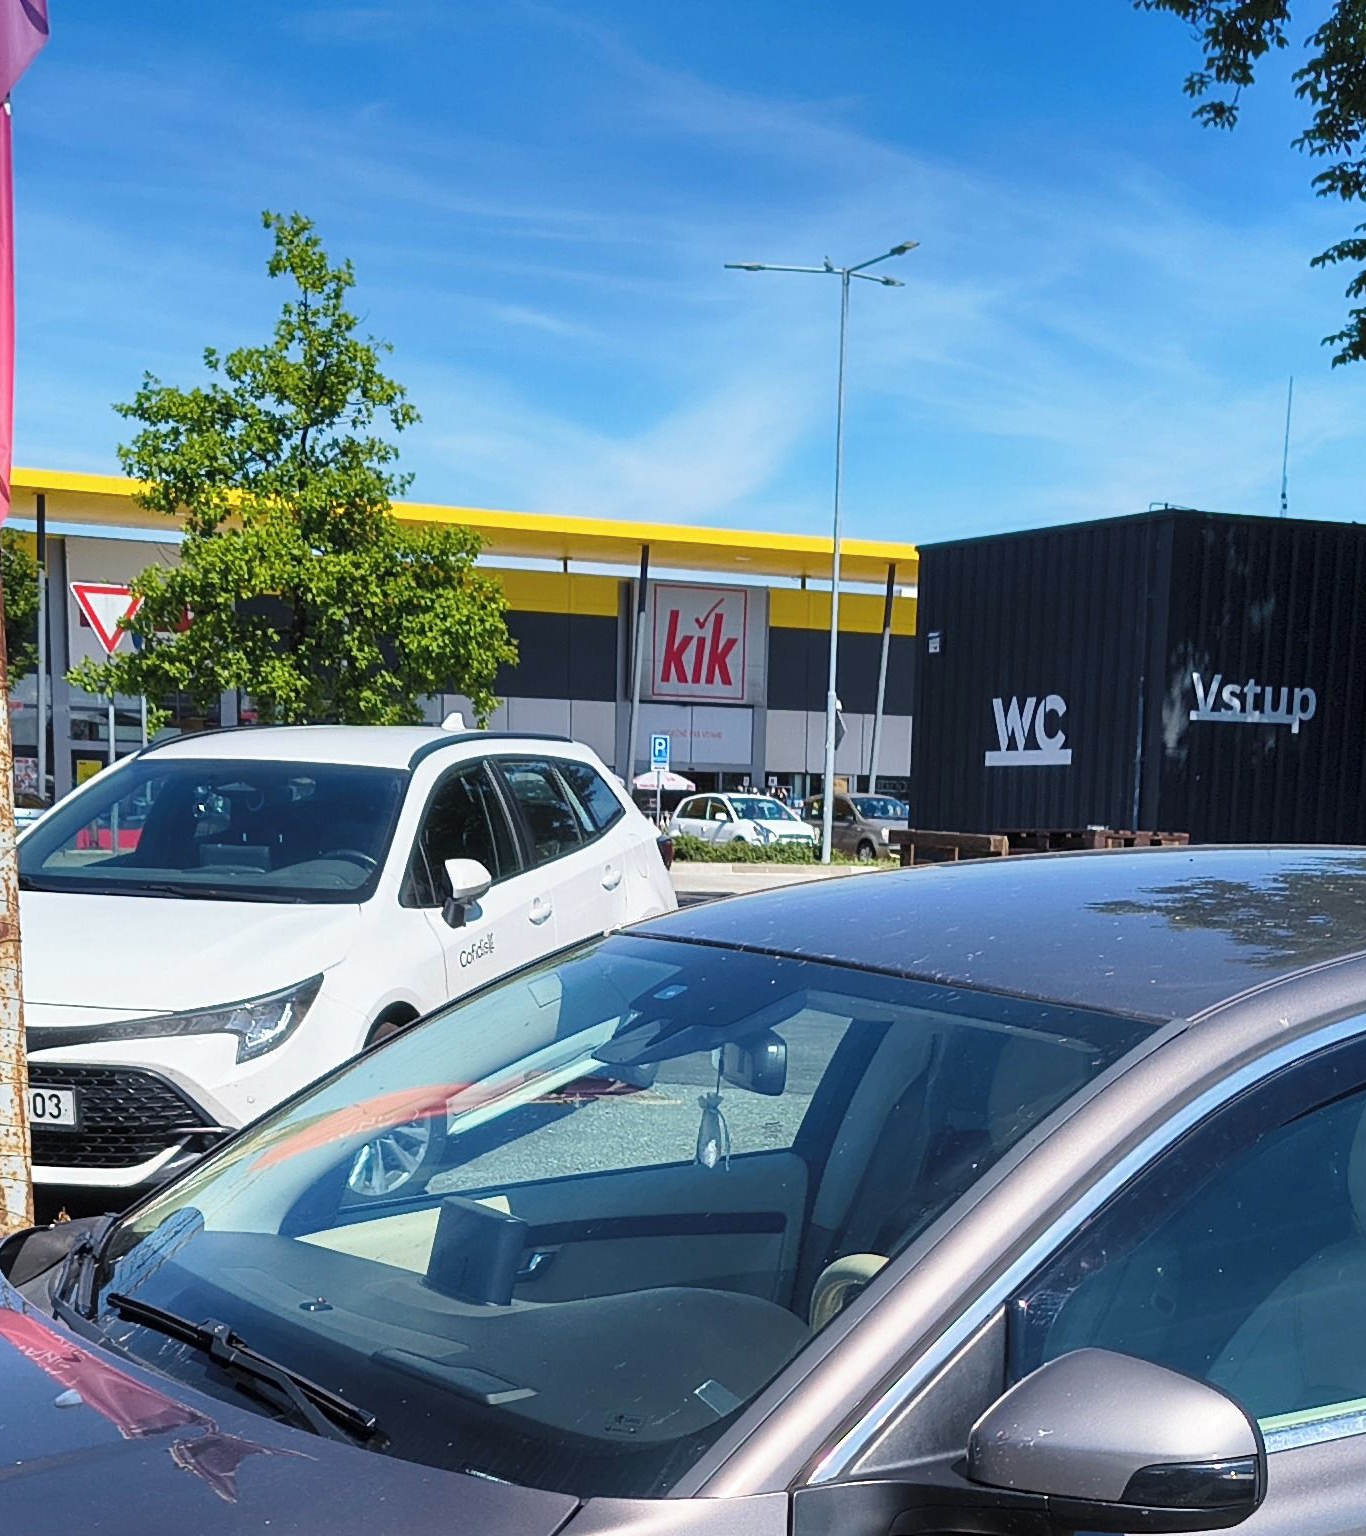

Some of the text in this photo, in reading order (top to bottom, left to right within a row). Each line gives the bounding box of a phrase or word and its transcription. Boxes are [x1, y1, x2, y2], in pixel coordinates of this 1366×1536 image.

[660, 600, 738, 686] kik
[991, 694, 1068, 755] WC
[1190, 672, 1317, 734] Vstup
[654, 738, 667, 757] P
